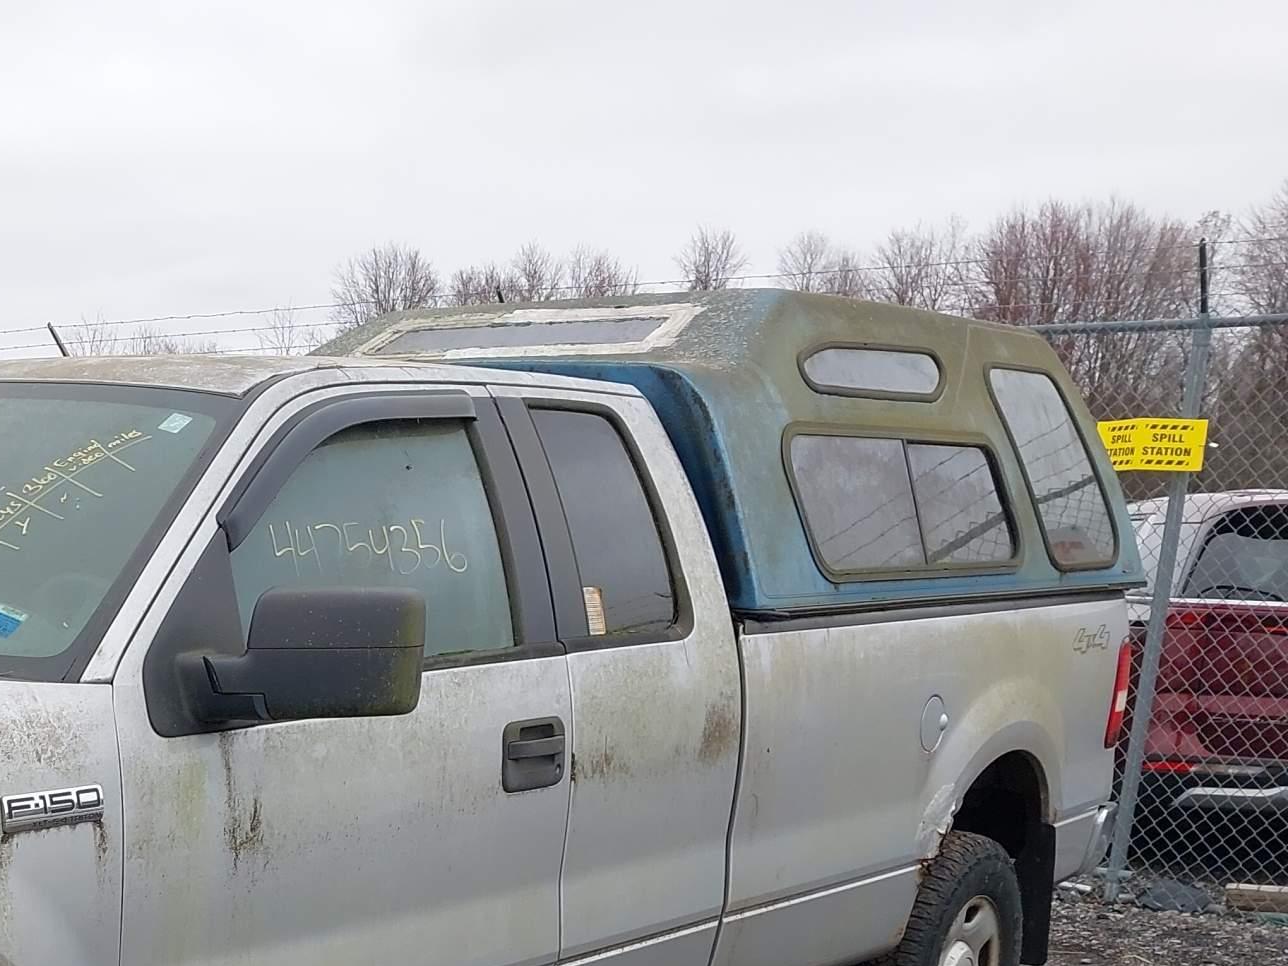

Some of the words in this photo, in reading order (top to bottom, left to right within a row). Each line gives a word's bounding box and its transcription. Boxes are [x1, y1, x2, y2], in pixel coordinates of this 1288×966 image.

[1111, 434, 1132, 444] SPILL
[1151, 432, 1185, 443] SPILL
[1107, 446, 1135, 457] TATION
[1142, 446, 1192, 457] STATION
[269, 519, 468, 576] 44754356
[6, 787, 101, 819] F-150
